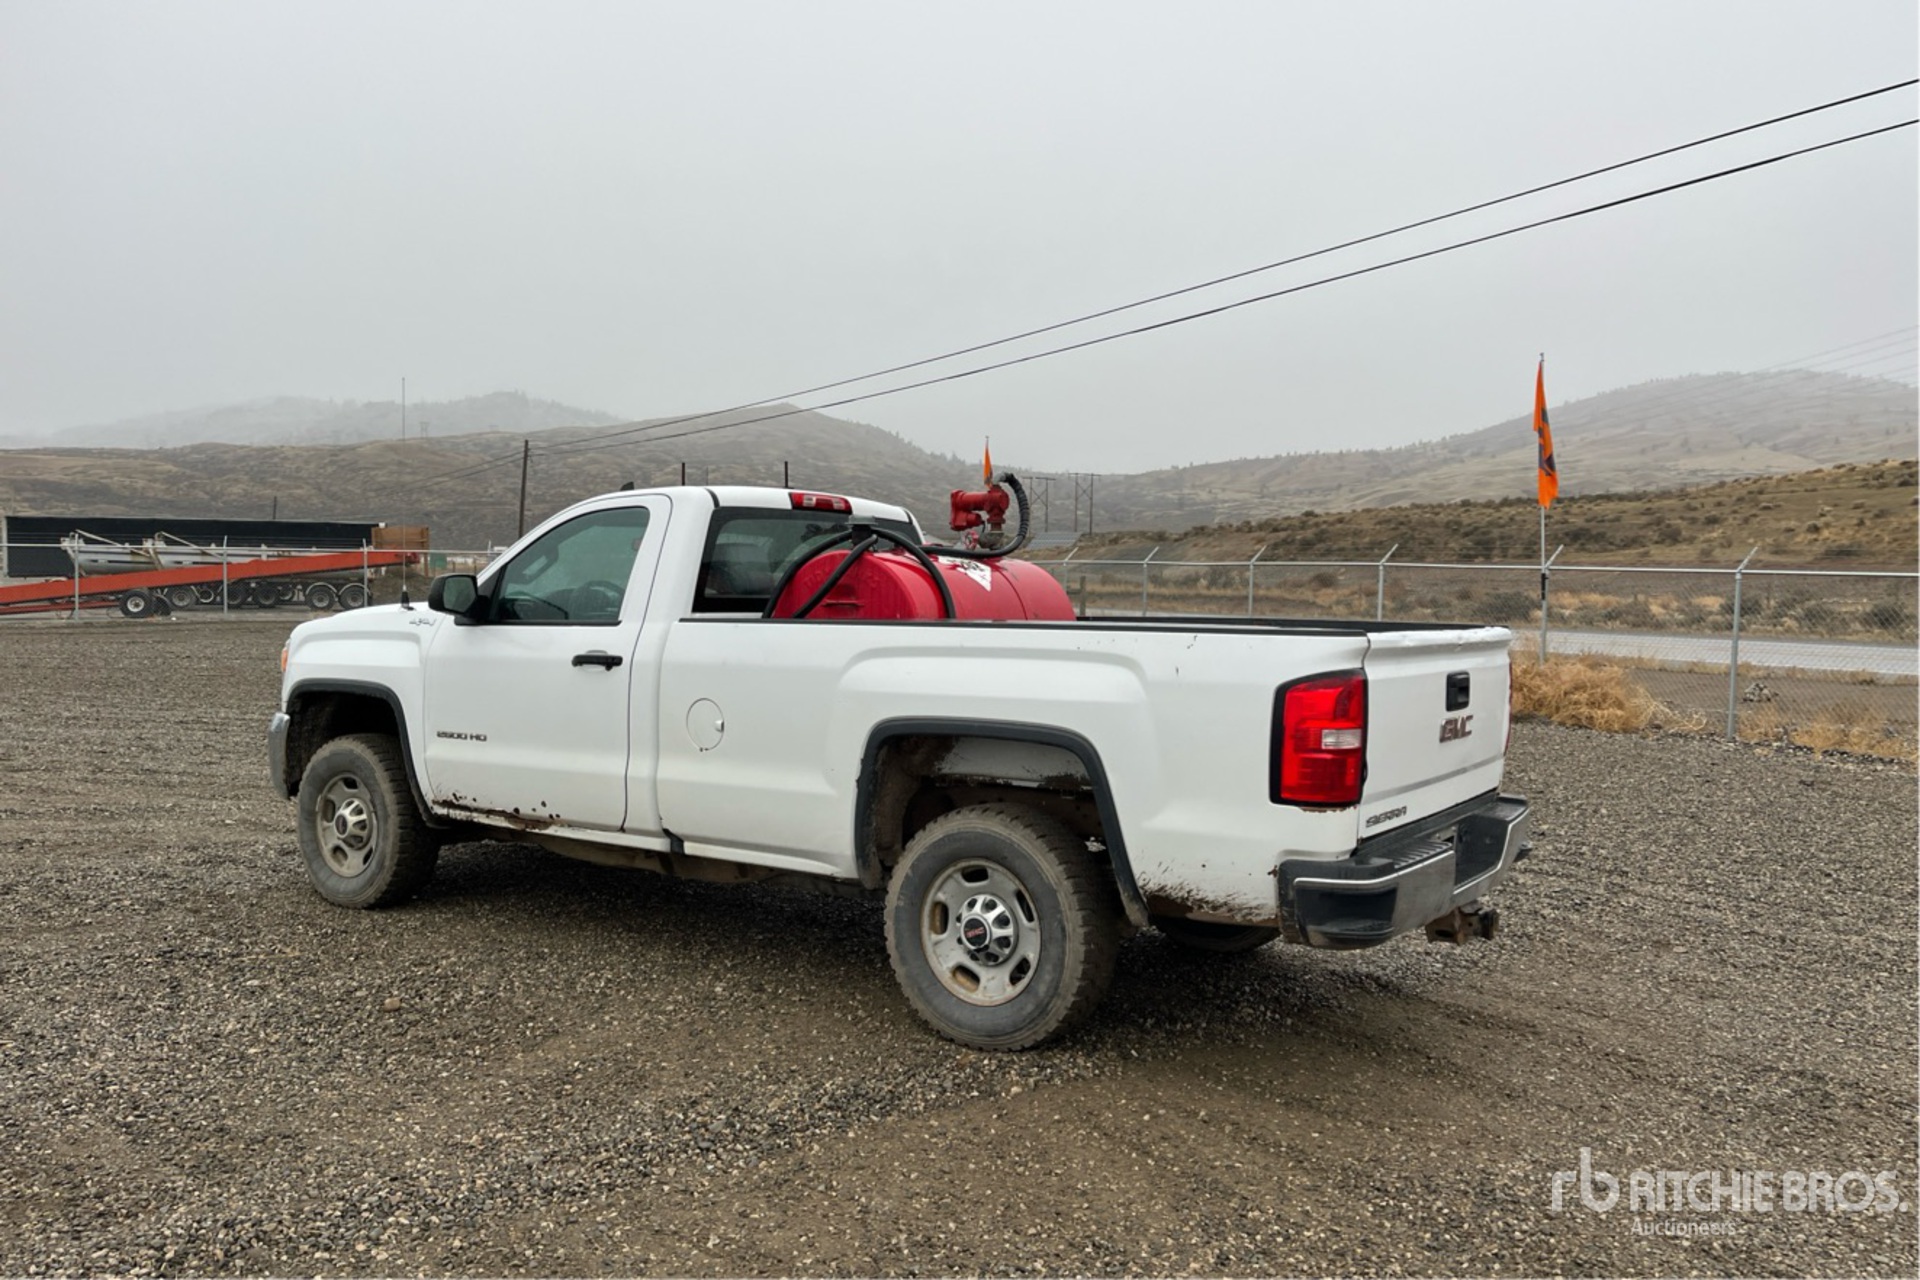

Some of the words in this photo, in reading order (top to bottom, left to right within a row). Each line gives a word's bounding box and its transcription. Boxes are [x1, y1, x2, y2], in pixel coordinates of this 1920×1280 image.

[469, 733, 487, 742] HD
[1439, 715, 1473, 743] GMC
[1366, 806, 1407, 827] SIERRA
